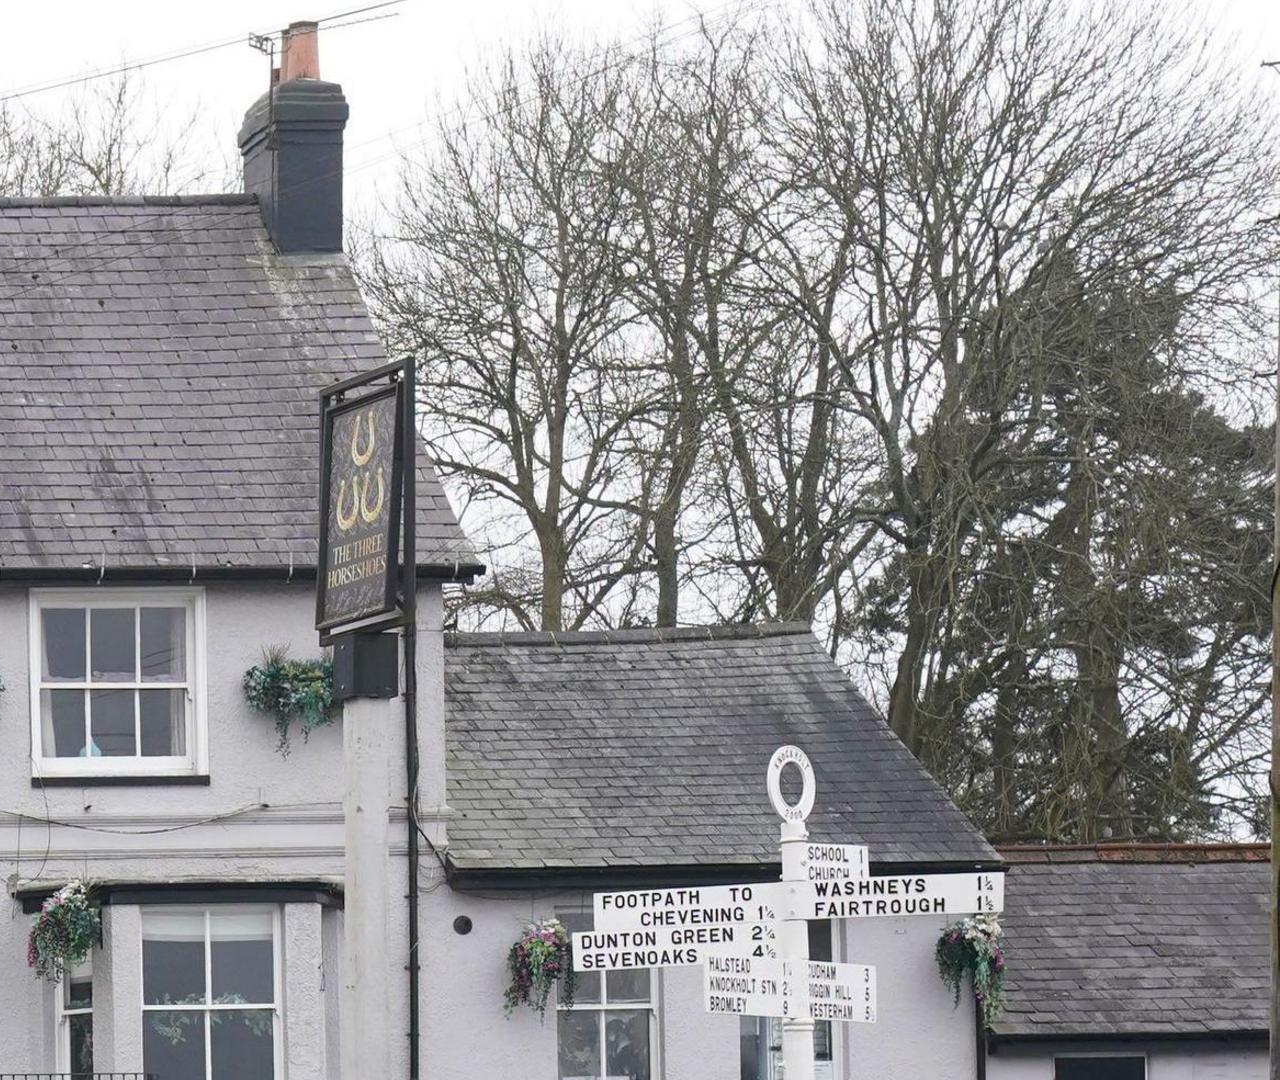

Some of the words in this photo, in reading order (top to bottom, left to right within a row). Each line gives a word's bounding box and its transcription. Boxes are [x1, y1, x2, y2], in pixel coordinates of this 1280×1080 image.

[333, 544, 351, 565] THE
[353, 533, 383, 558] THREE
[328, 554, 386, 589] HORSESHOES
[808, 846, 849, 863] SCHOOL
[808, 866, 849, 880] CHURCH
[815, 878, 926, 897] WASHNEYS
[602, 890, 700, 909] FOOTPATH
[730, 887, 752, 902] TO
[815, 897, 945, 916] FAIRTROUGH
[641, 907, 745, 926] CHEVENING
[581, 932, 656, 950] DUNTON
[671, 927, 734, 945] GREEN
[583, 949, 697, 969] SEVENOAKS
[709, 956, 751, 974] HALSTEAD
[864, 968, 870, 982] 3
[710, 977, 756, 994] KNOCKHOLT
[761, 980, 777, 995] STN
[835, 985, 852, 1000] HILL
[710, 996, 747, 1013] BROMLEY
[783, 1001, 789, 1015] 9
